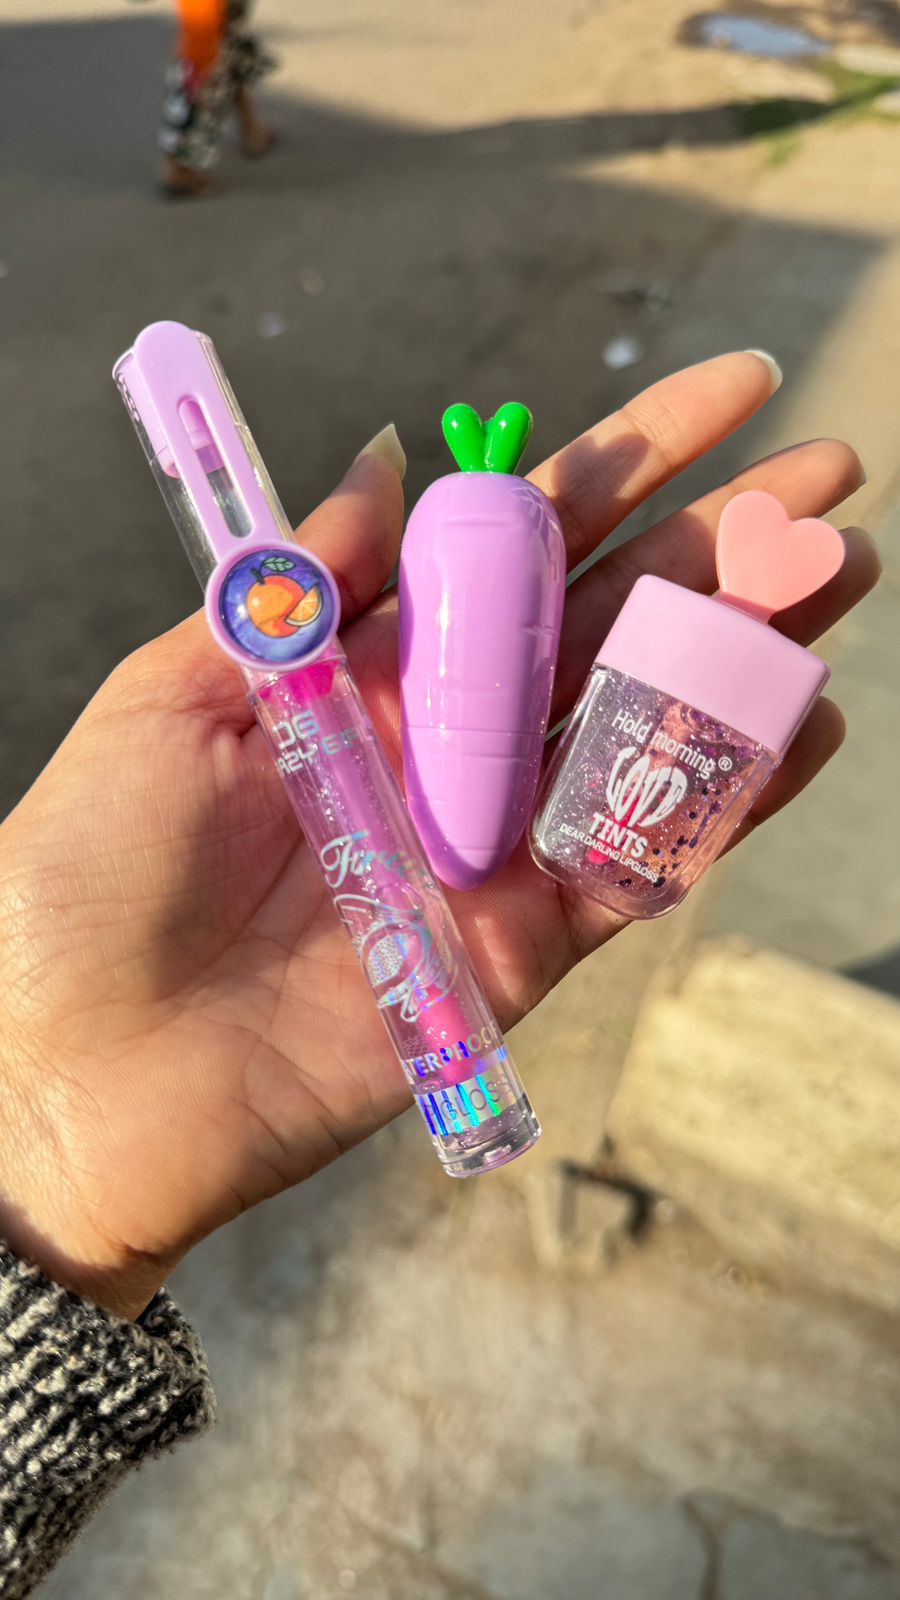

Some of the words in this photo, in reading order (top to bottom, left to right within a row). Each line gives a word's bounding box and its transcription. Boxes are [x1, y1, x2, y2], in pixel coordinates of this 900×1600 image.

[611, 708, 653, 744] Hold
[606, 745, 689, 828] LOVE
[559, 822, 586, 843] DEAR
[583, 836, 621, 861] DARLING
[618, 854, 661, 884] LIPGLOSS
[588, 811, 649, 859] TINTS
